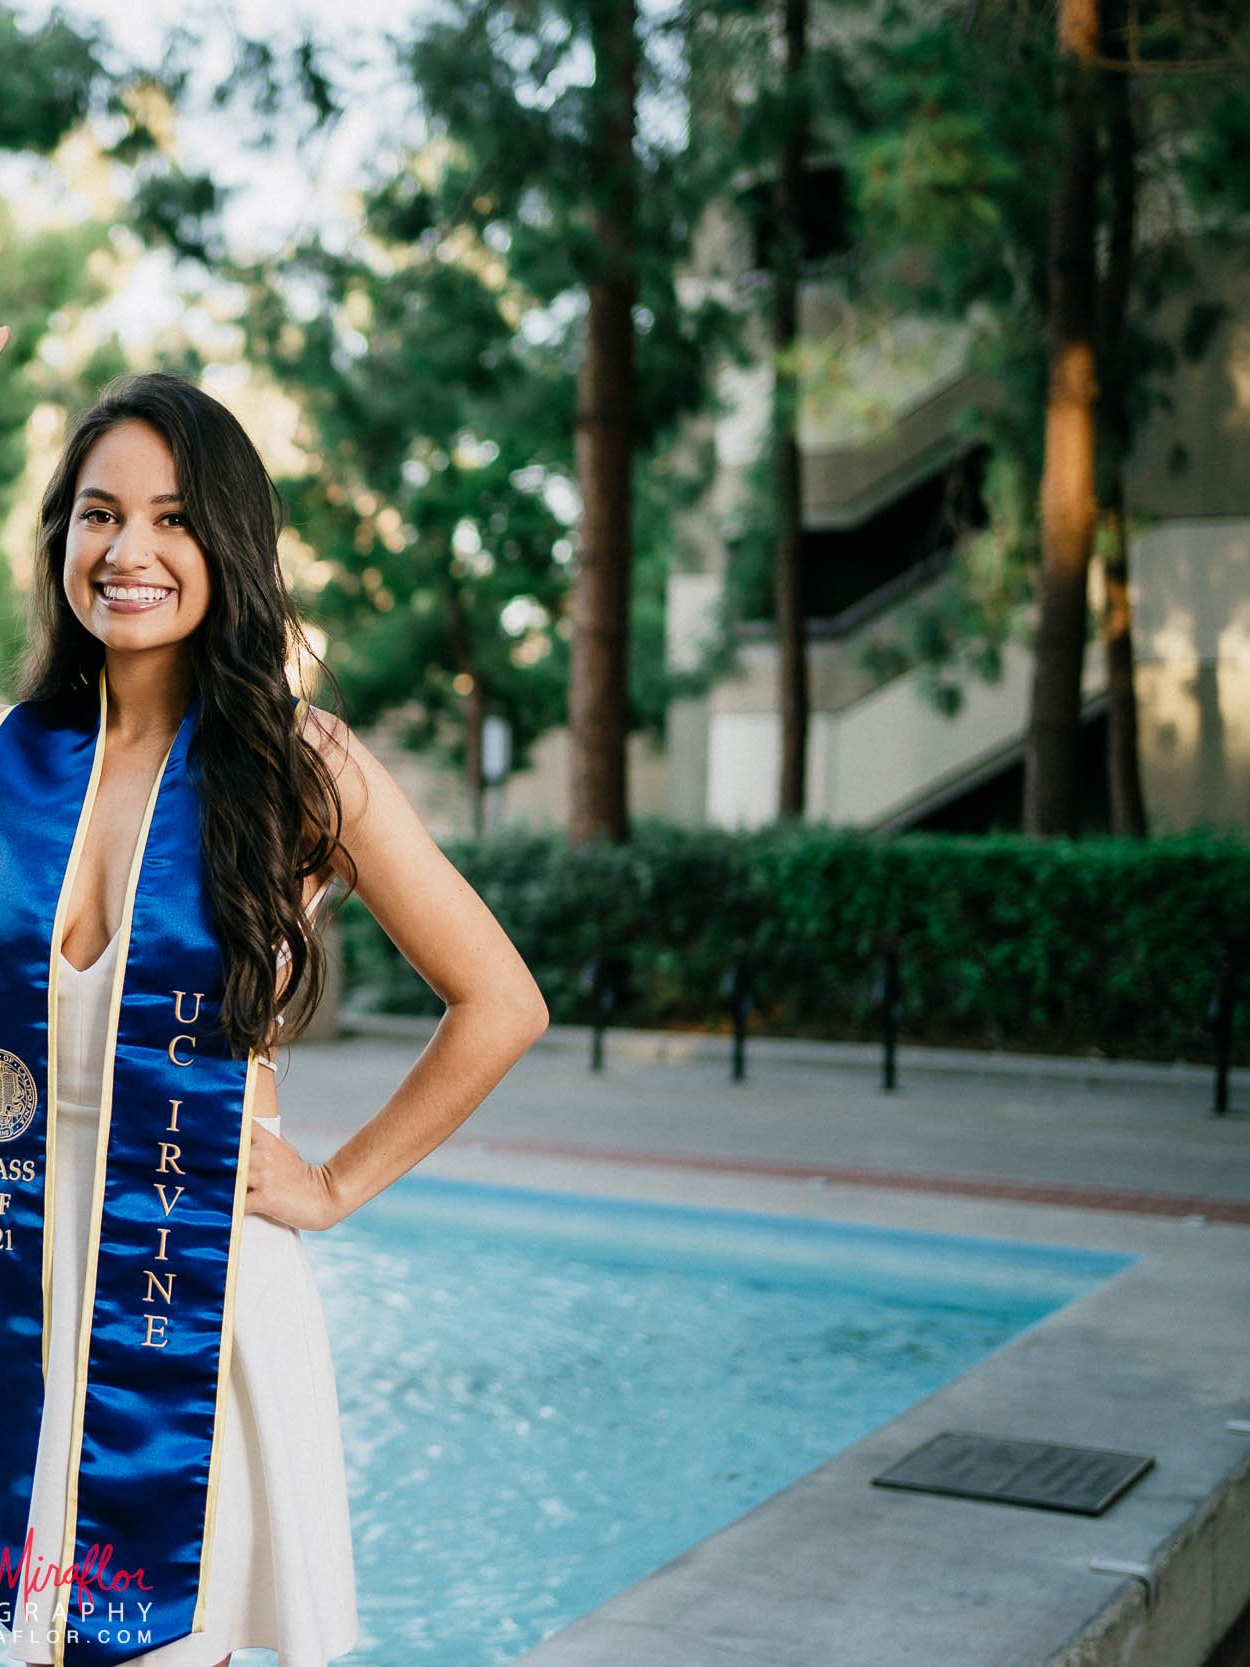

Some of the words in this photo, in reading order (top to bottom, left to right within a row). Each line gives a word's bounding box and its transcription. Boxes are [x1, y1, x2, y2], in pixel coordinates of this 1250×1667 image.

[167, 990, 205, 1067] UC
[17, 1066, 33, 1124] CALIFORNIA
[141, 1099, 187, 1349] IRVINE
